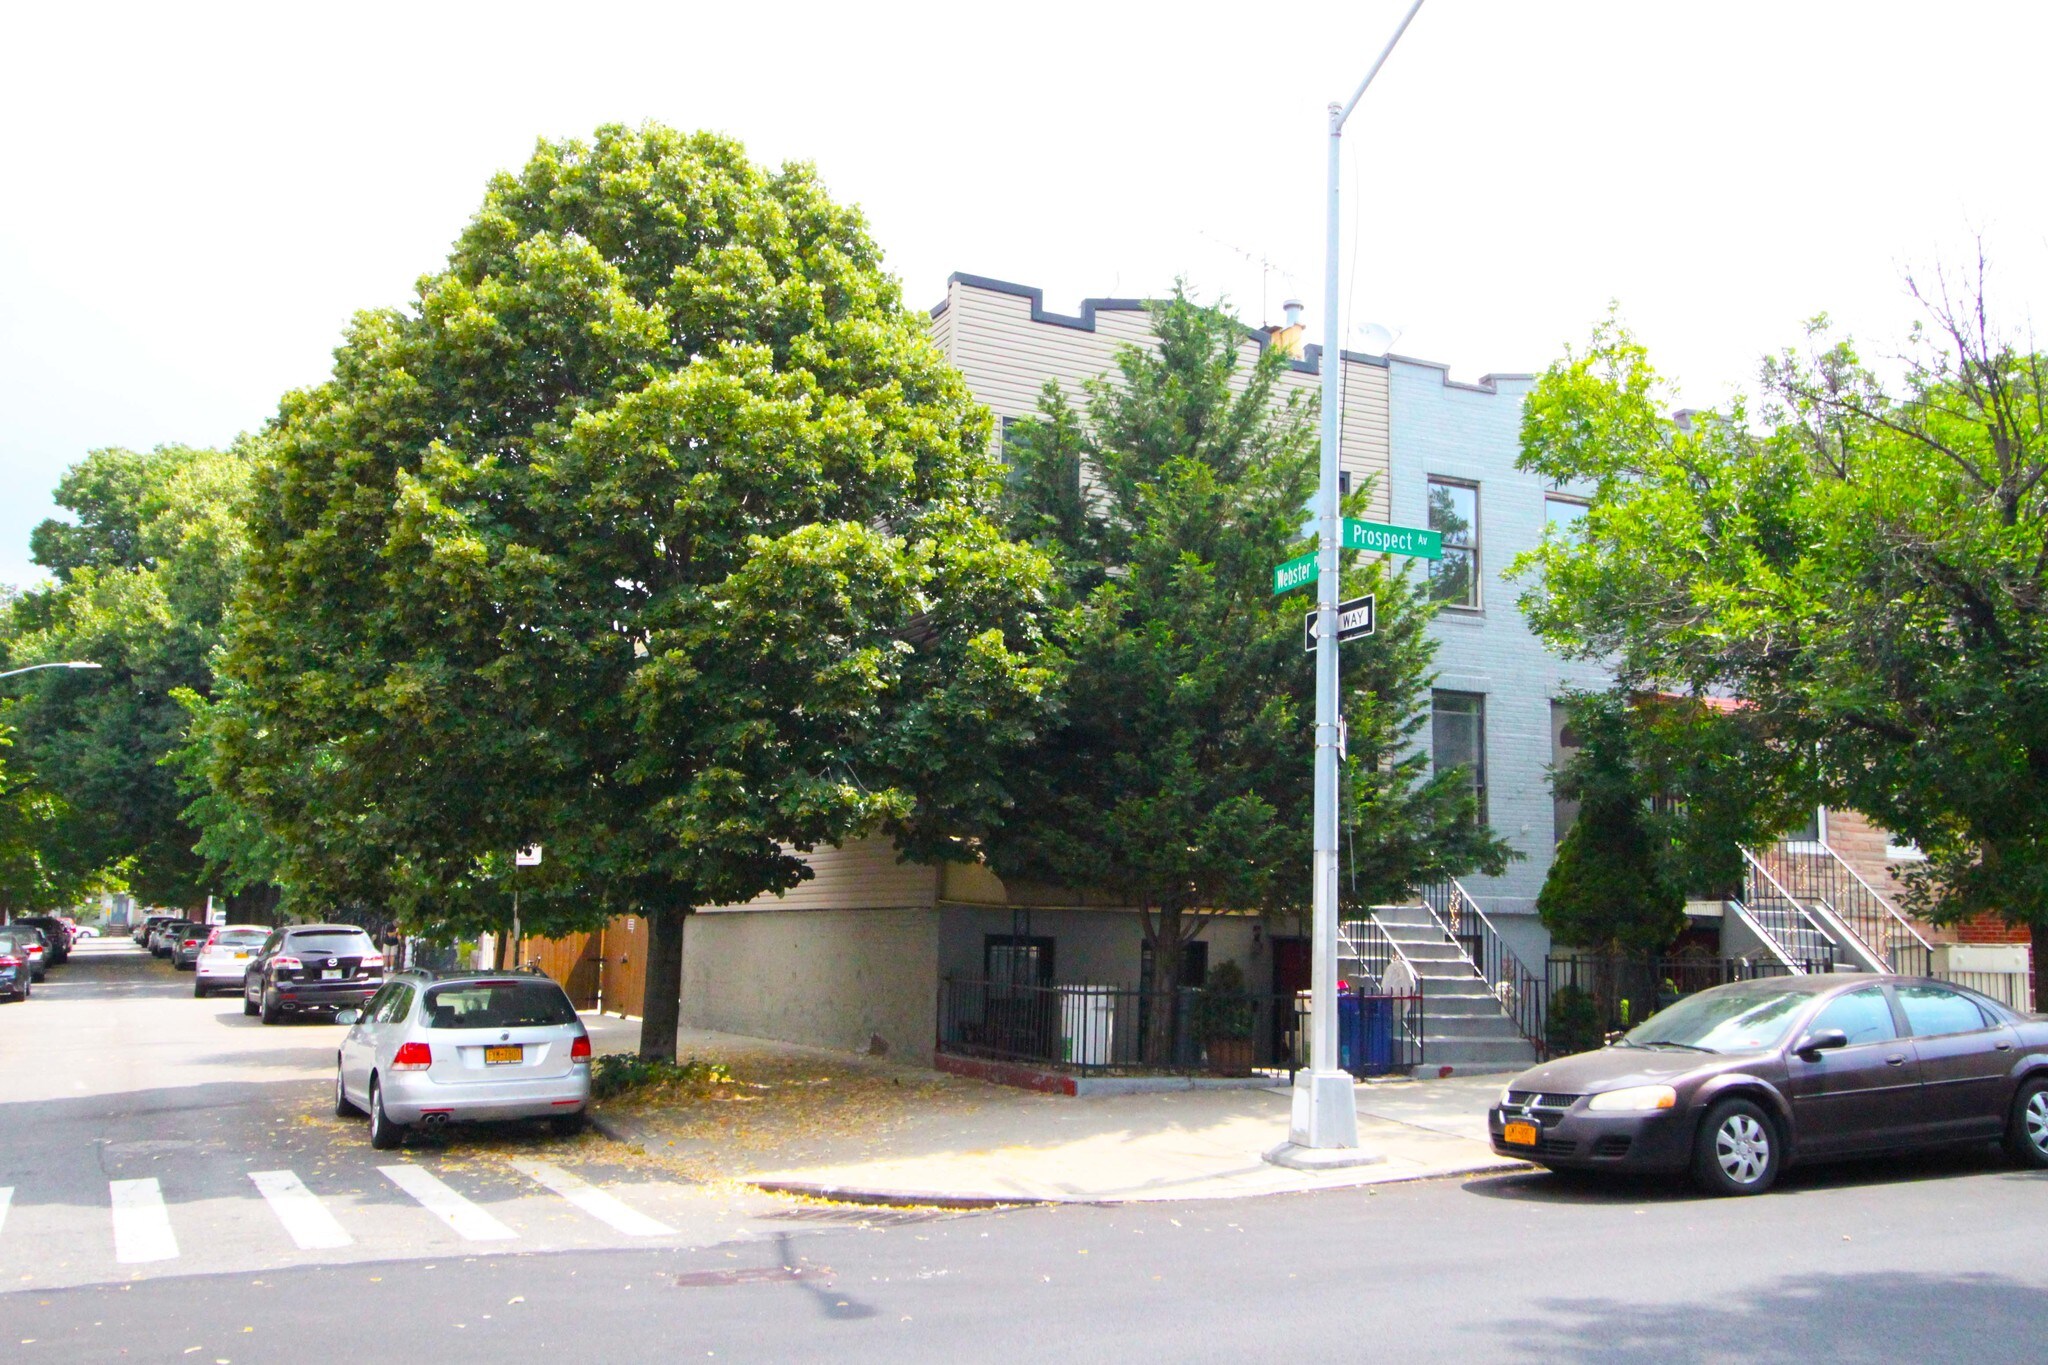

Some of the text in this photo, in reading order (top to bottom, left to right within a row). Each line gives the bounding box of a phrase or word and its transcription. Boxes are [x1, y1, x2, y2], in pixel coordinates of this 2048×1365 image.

[1353, 524, 1428, 551] Prospect Av
[1277, 562, 1311, 589] Webster
[1343, 610, 1364, 628] WAY
